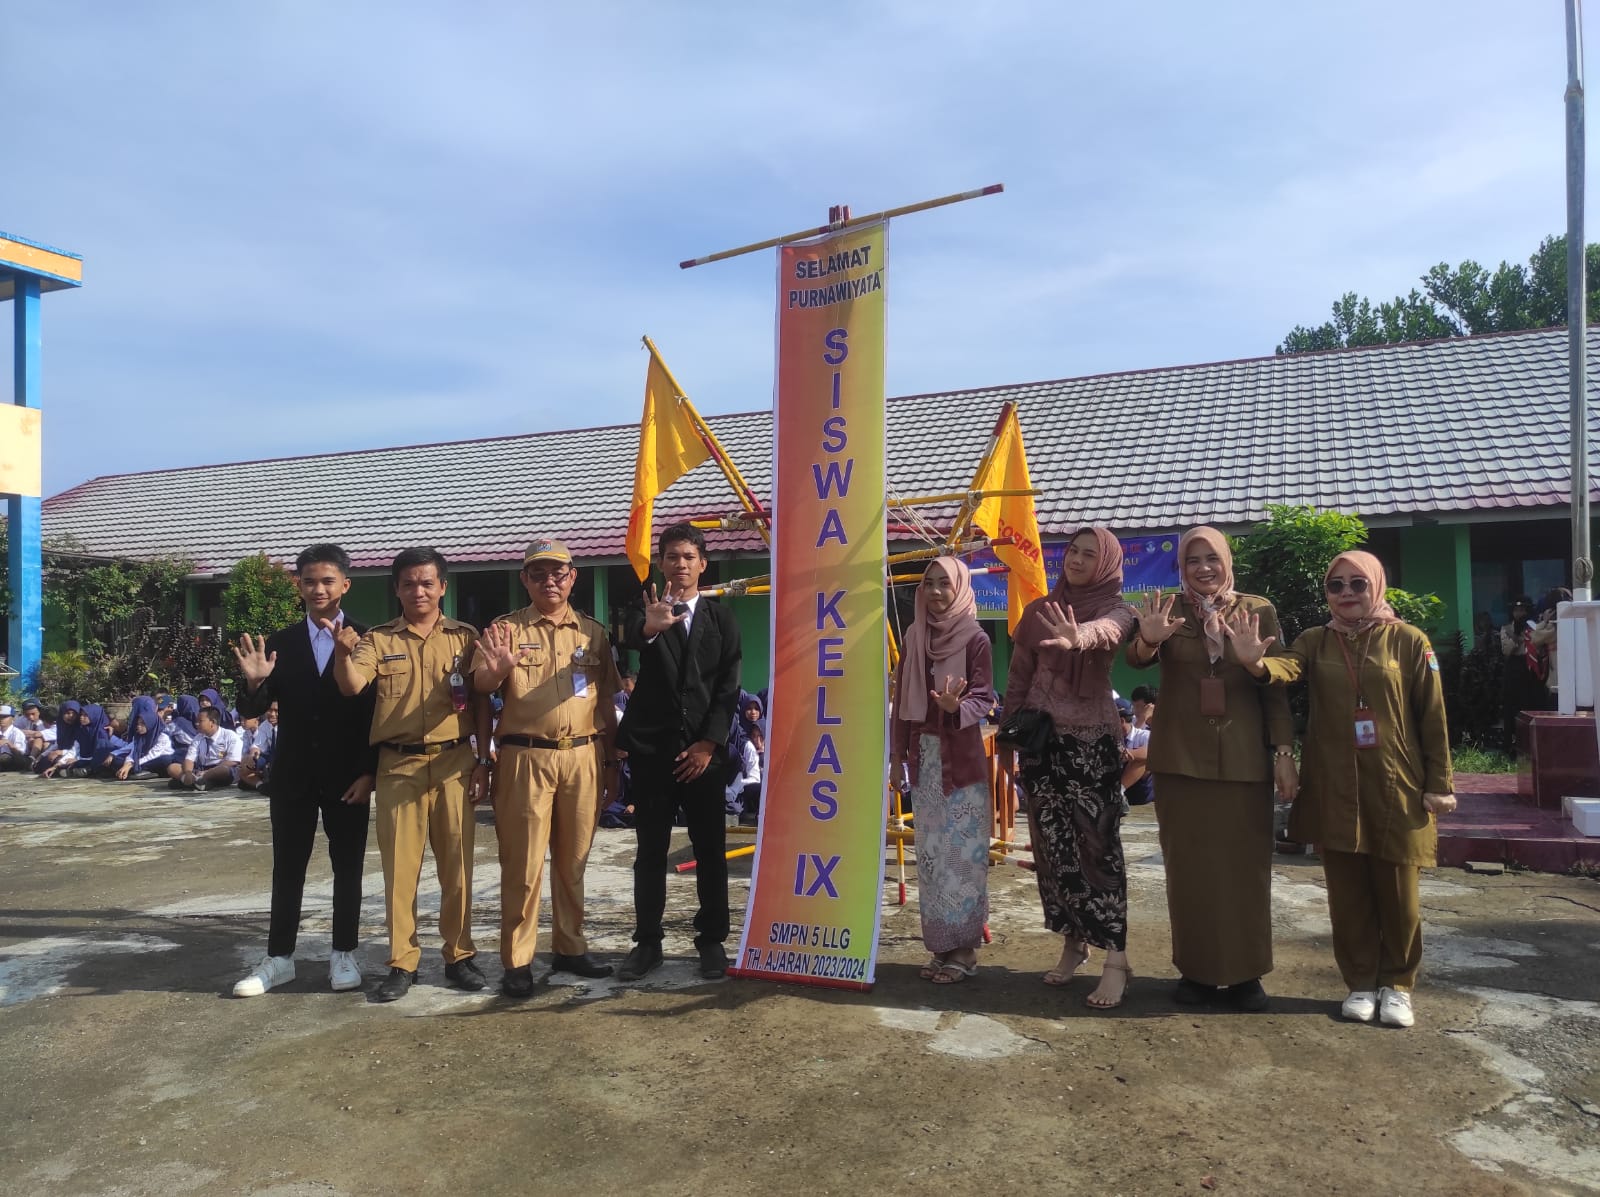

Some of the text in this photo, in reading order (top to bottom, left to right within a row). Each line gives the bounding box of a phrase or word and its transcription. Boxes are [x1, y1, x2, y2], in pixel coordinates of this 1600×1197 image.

[796, 246, 871, 279] SELAMAT
[789, 271, 881, 309] PURNAWIYATA
[793, 328, 854, 898] SISWA KELAS IX
[770, 922, 850, 950] SMPN 5 LLG
[746, 948, 866, 980] TH. AJARAN 2023/2024
